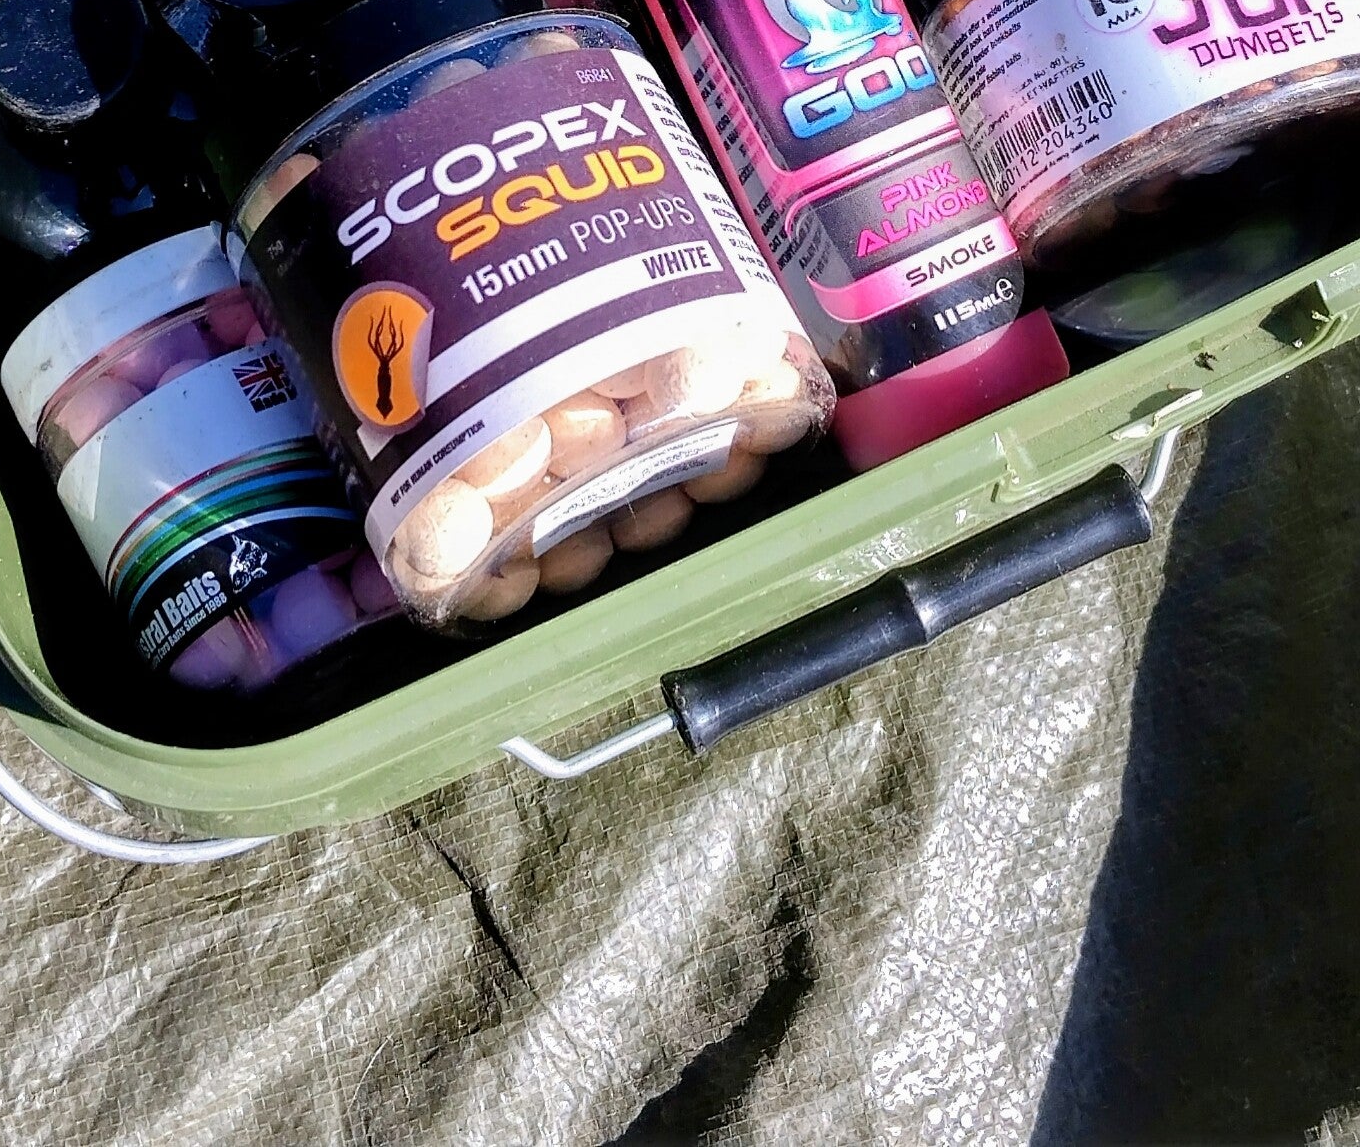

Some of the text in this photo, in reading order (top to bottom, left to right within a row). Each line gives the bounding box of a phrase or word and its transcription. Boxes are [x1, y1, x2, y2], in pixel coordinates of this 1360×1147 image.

[985, 4, 1002, 20] wide
[1189, 2, 1344, 68] DUMBELLS
[1041, 101, 1113, 156] 204340
[337, 98, 647, 266] SCOPEX
[437, 145, 666, 262] SQUID
[880, 161, 959, 212] PINK
[856, 179, 988, 258] ALMOND
[461, 236, 569, 305] 15mm
[569, 196, 696, 254] POP-UPS
[643, 245, 711, 281] WHITE
[905, 235, 996, 287] SMOKE
[390, 419, 485, 507] NOT FOR HUMAN CONSUMPTION
[162, 570, 221, 629] Baits
[183, 608, 207, 633] Since
[204, 591, 227, 615] 1988
